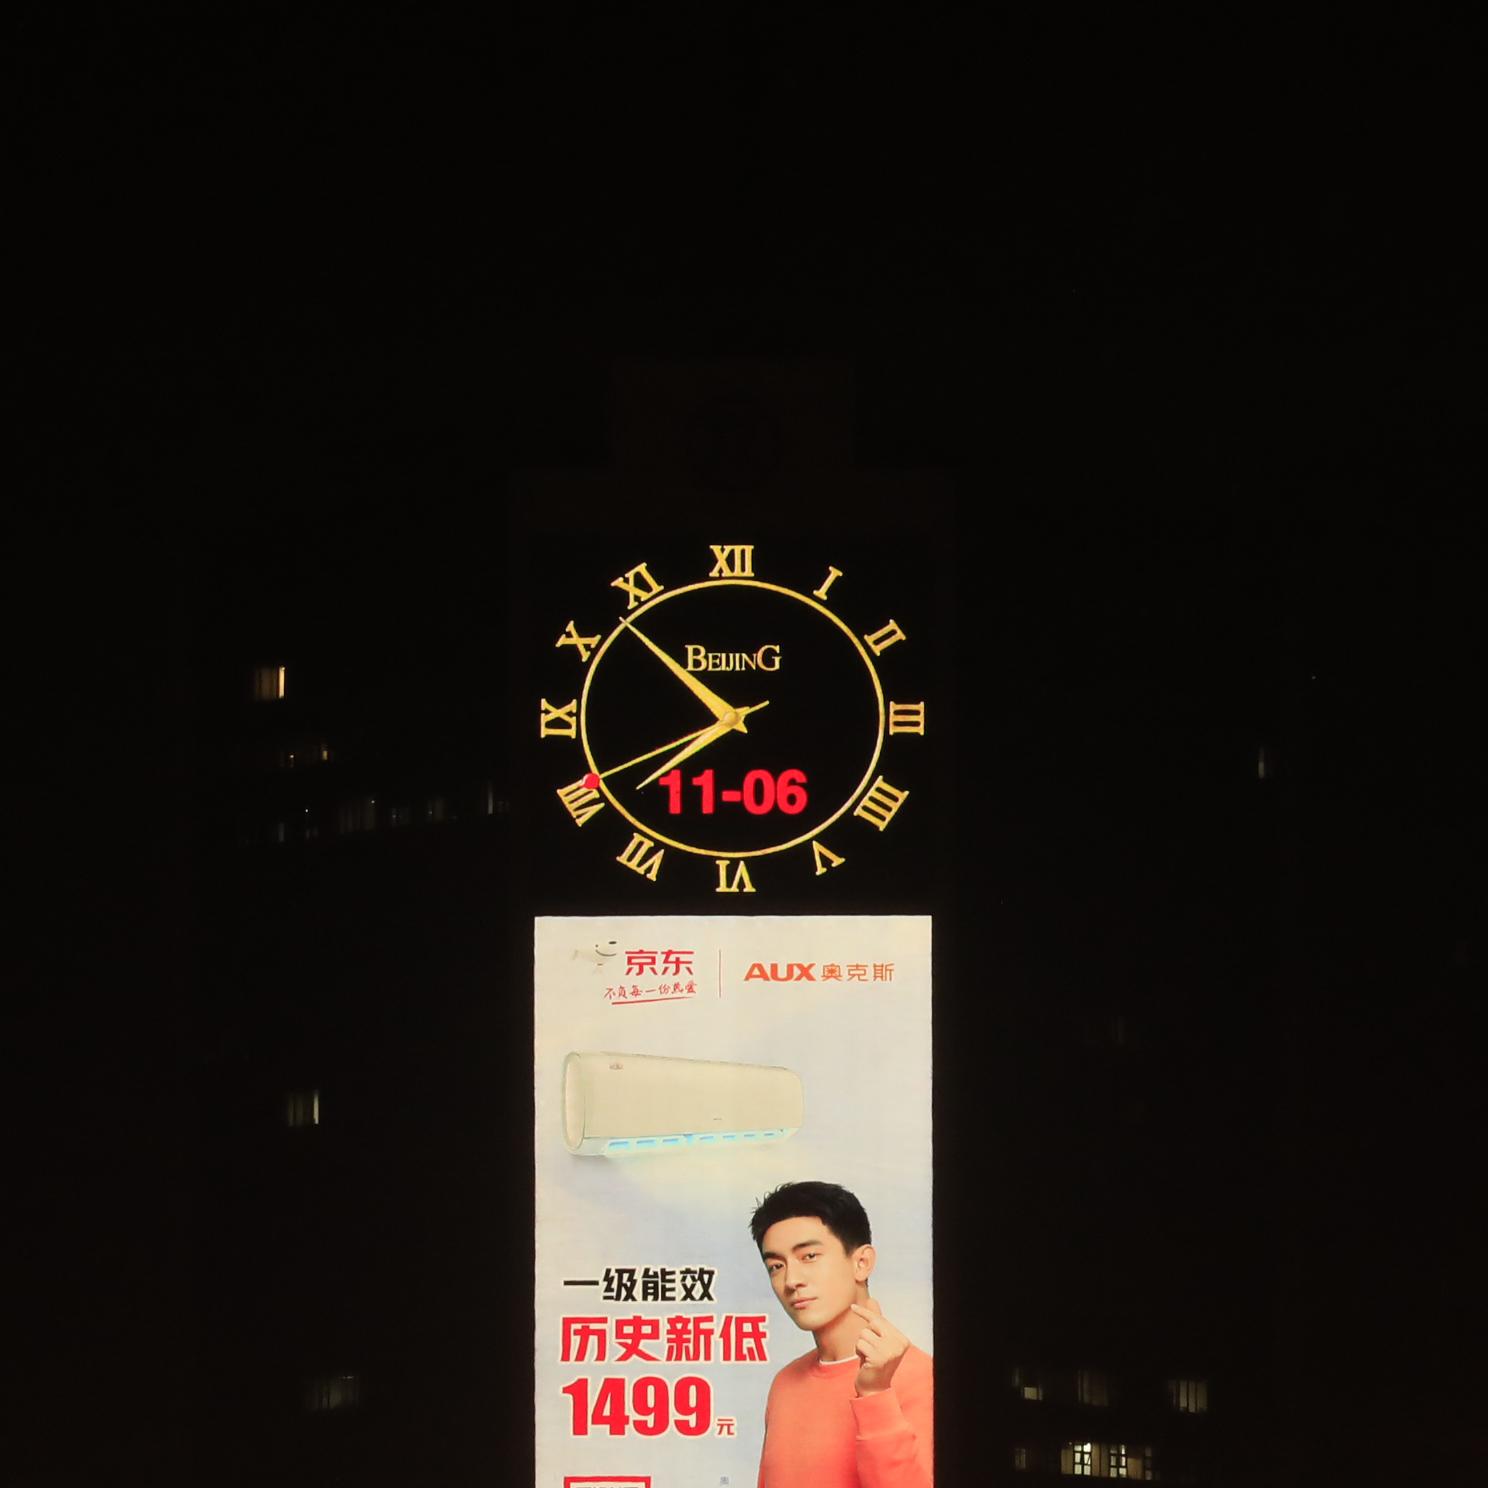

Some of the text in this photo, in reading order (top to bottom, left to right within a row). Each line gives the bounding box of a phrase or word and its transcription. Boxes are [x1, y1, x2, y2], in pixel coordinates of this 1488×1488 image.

[709, 545, 754, 577] XII
[611, 563, 664, 609] XI
[556, 620, 601, 662] X
[864, 619, 906, 656] II
[684, 645, 781, 672] BEIJING
[540, 698, 577, 738] IX
[889, 701, 924, 735] III
[658, 769, 808, 815] 11-06
[616, 833, 665, 881] VII
[813, 841, 845, 876] V
[715, 860, 756, 892] VI
[625, 949, 694, 976] 京东
[744, 963, 894, 982] AUX 奥克斯
[563, 1267, 715, 1302] 一级能效
[560, 1315, 768, 1362] 历史新低
[562, 1376, 735, 1436] 1499 元
